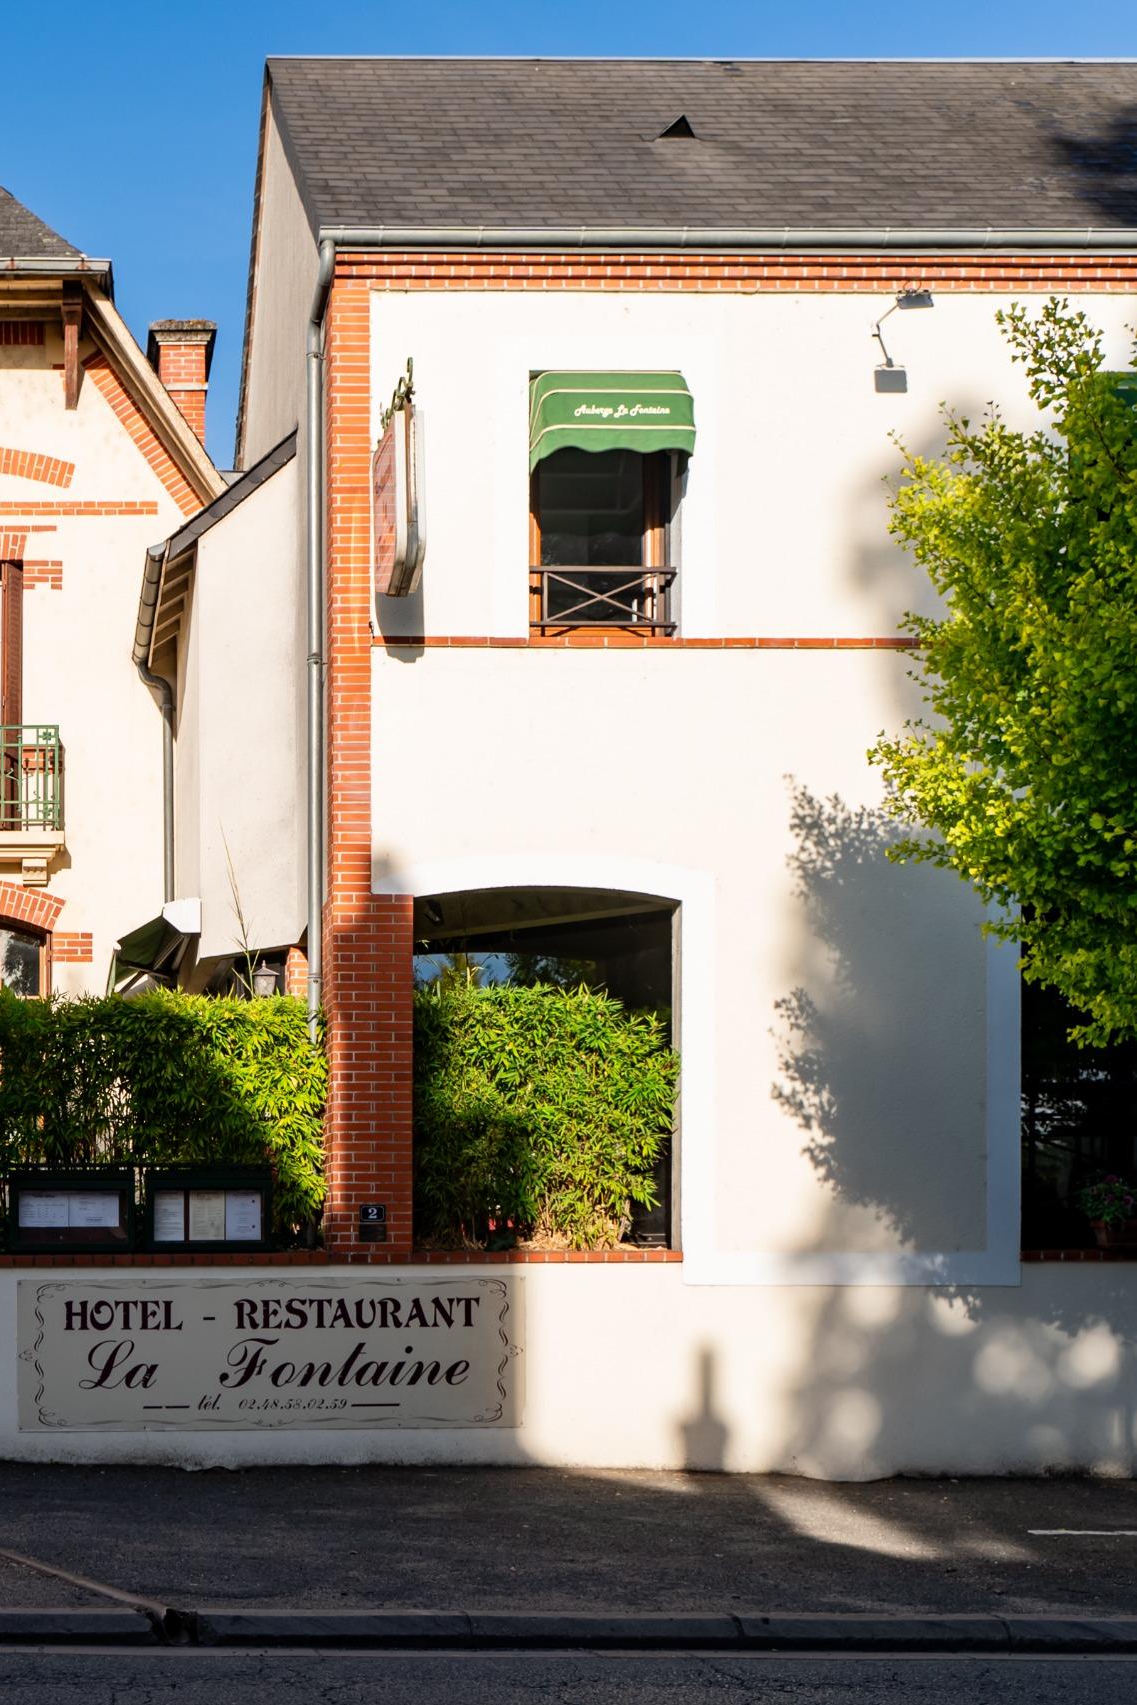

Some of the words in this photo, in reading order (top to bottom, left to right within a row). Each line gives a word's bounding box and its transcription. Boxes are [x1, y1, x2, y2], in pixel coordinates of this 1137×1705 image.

[574, 404, 613, 418] Auberge
[614, 404, 629, 418] La
[630, 404, 671, 417] Fontaine
[368, 1207, 377, 1219] 2
[64, 1299, 184, 1331] HOTEL
[234, 1297, 480, 1331] RESTAURANT
[79, 1339, 159, 1389] La
[219, 1338, 470, 1388] Fontaine
[238, 1398, 347, 1411] 02.48.58.02.59
